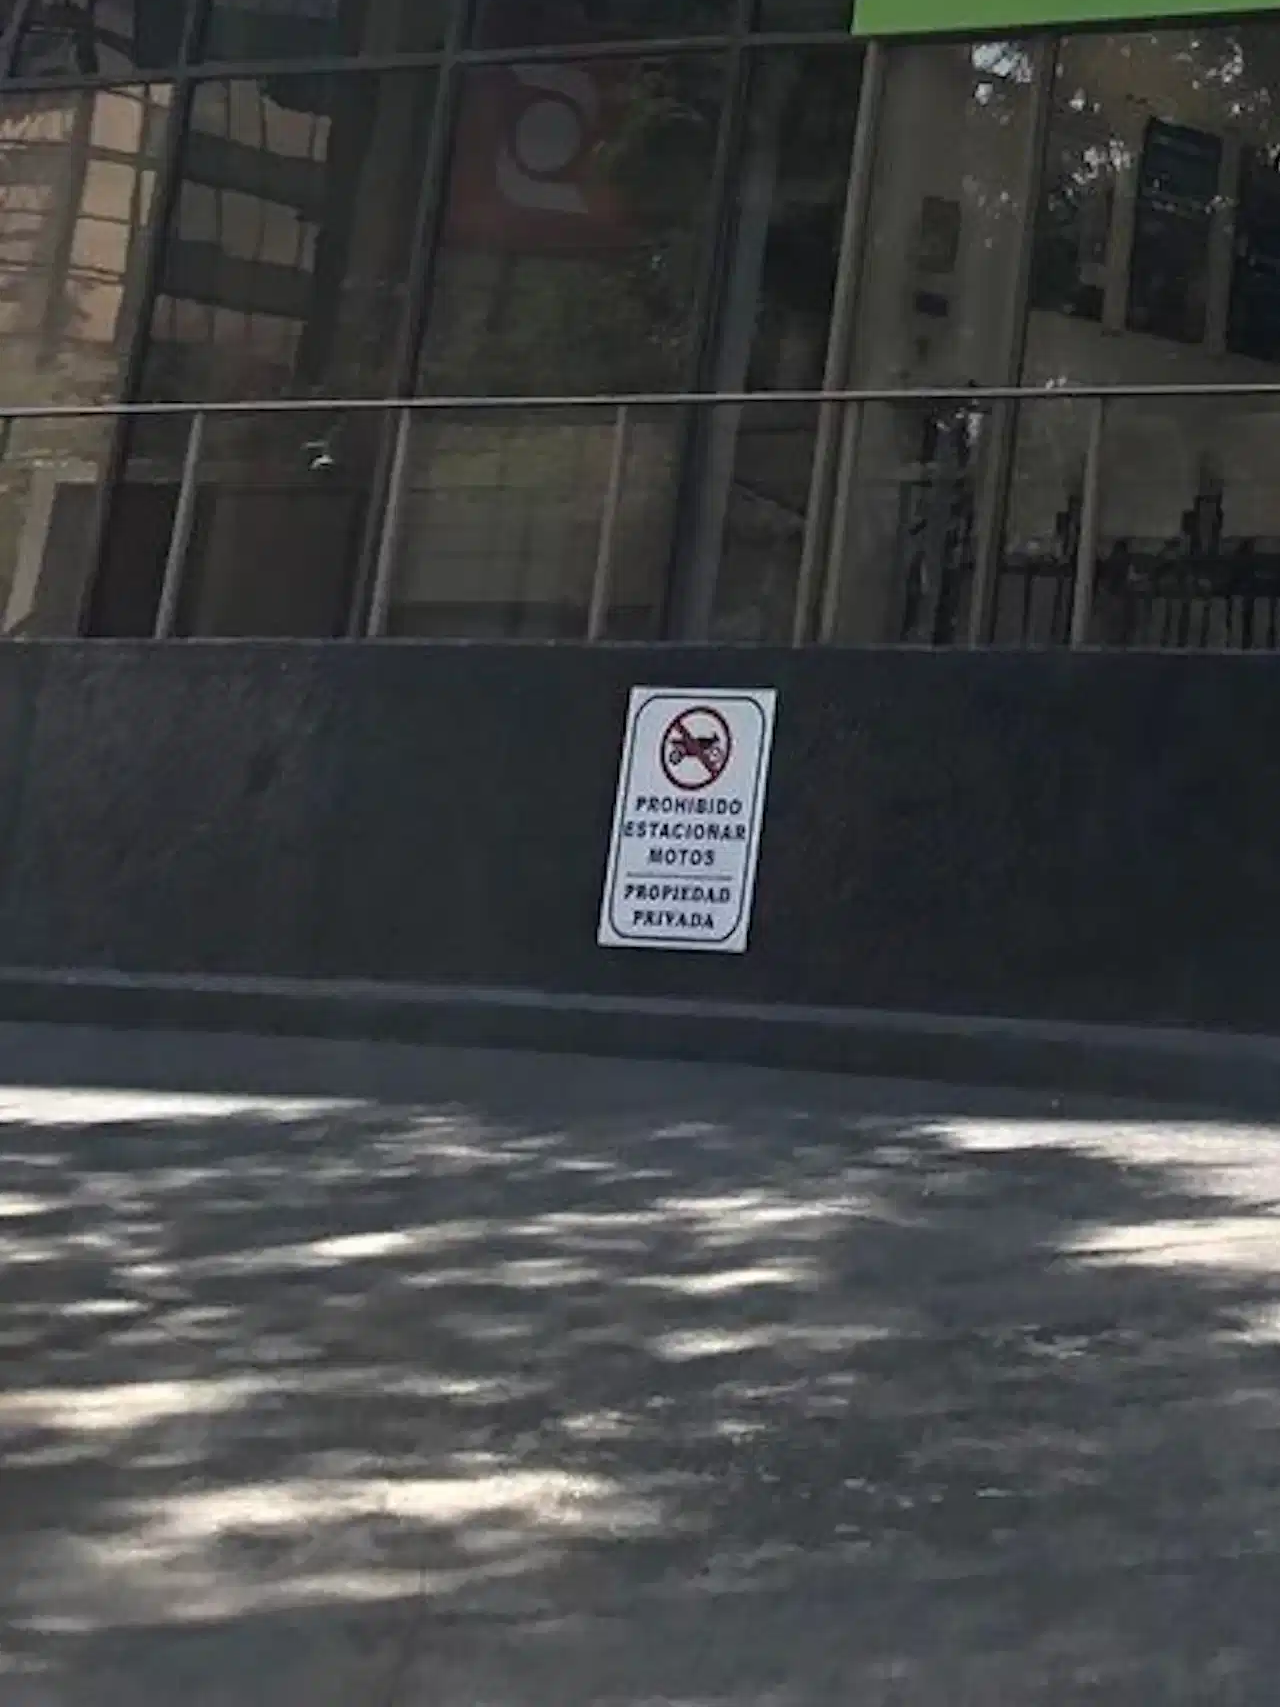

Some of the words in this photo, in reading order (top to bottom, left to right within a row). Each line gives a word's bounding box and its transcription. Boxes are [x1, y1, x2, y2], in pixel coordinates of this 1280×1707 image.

[635, 796, 742, 815] PROHIBIDO
[624, 821, 746, 840] ESTACIONAR
[649, 848, 714, 866] MOTOS
[624, 883, 730, 904] PROPIEDAD
[633, 910, 714, 929] PRIVADA
